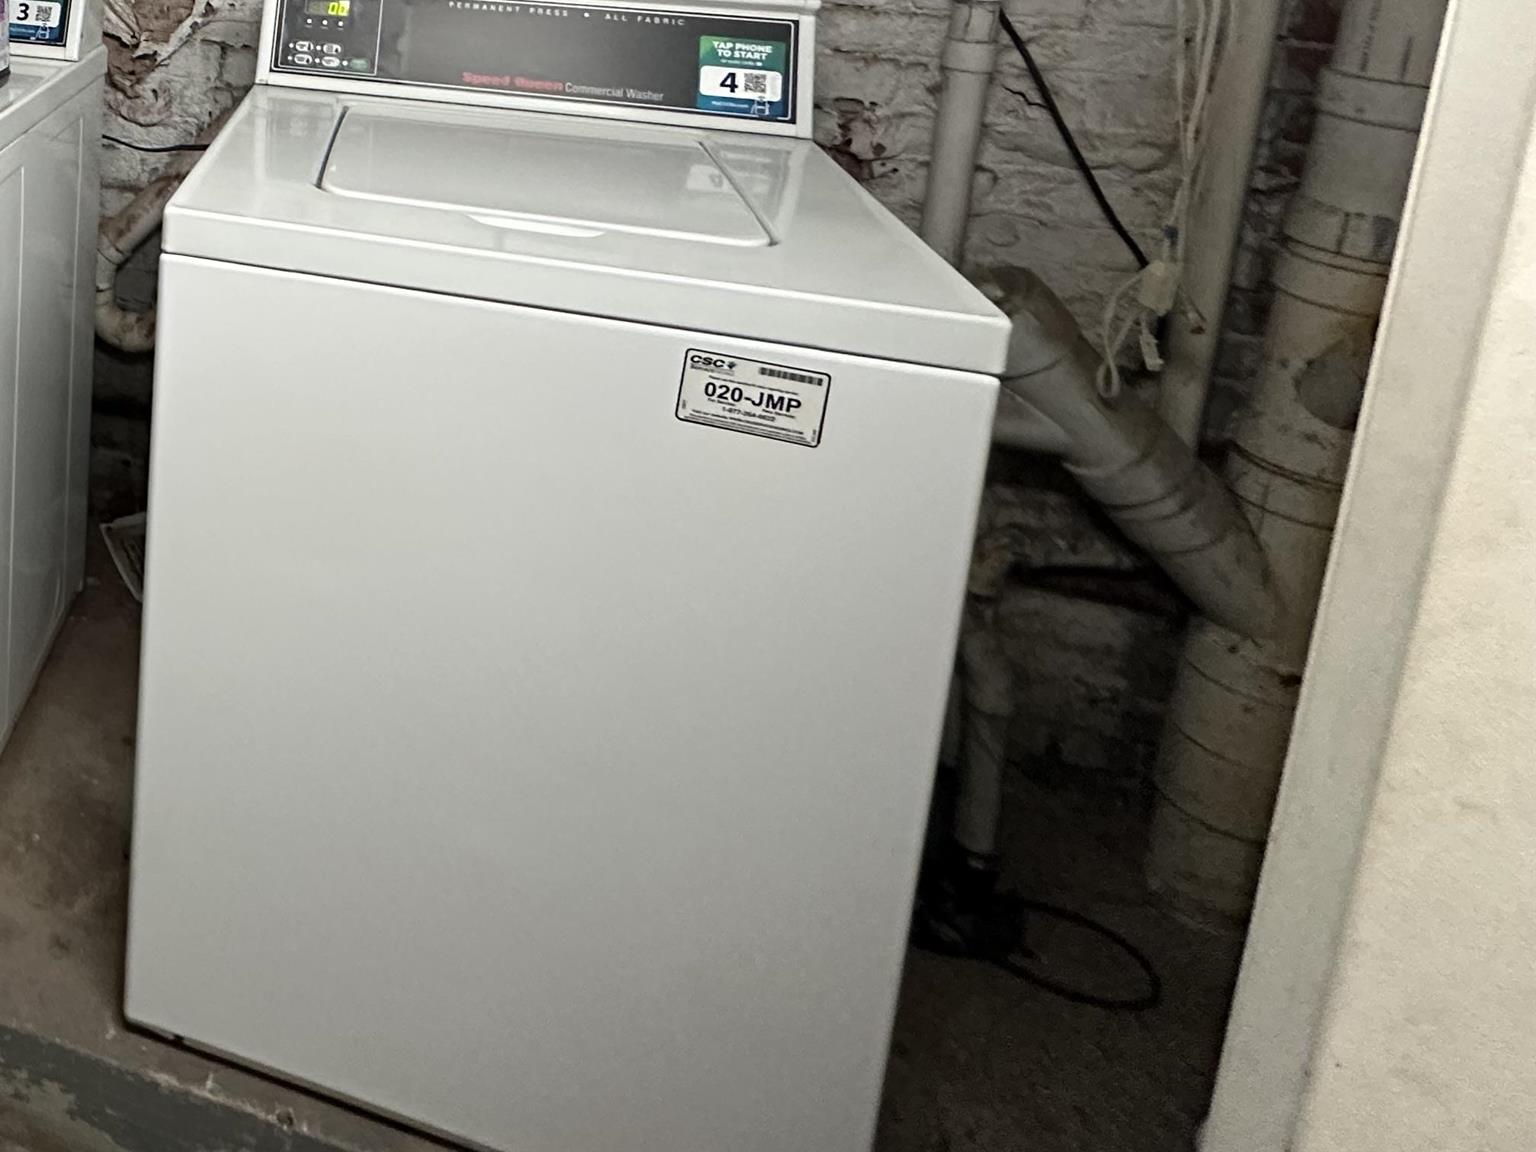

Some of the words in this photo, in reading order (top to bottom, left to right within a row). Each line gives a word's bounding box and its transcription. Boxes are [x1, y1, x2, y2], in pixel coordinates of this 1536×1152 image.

[16, 3, 30, 21] 3
[448, 1, 521, 13] PERMANENT
[529, 6, 569, 17] PRESS
[604, 13, 628, 22] ALL
[637, 15, 686, 26] FABRIC
[712, 41, 734, 49] TAP
[735, 43, 773, 53] PHONE
[717, 49, 732, 57] TO
[734, 50, 768, 60] START
[565, 82, 624, 98] Commercial
[626, 88, 664, 101] Washer
[719, 72, 739, 93] 4
[690, 355, 726, 368] CSC
[704, 382, 802, 413] 020-JMP
